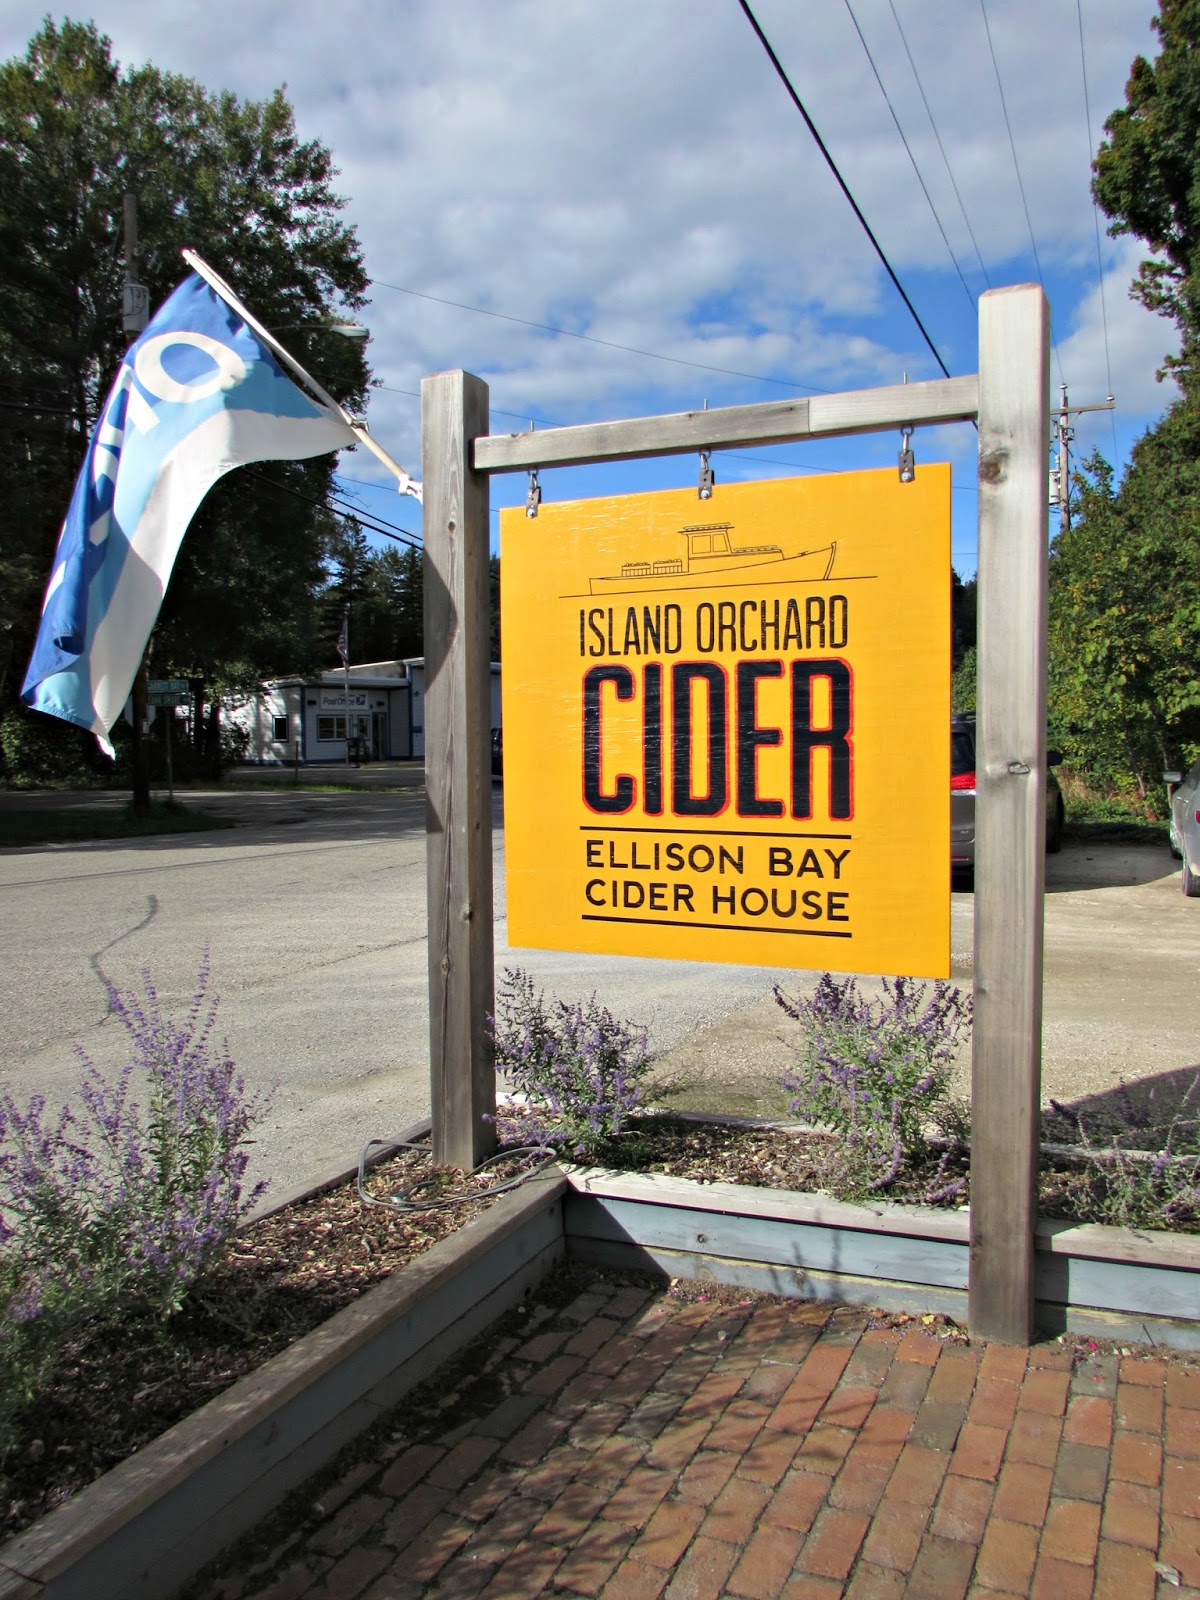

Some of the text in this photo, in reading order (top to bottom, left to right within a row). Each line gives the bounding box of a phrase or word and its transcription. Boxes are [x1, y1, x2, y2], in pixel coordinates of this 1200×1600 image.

[579, 594, 848, 657] ISLAND ORCHARD
[337, 697, 355, 706] Offce
[581, 656, 855, 822] CIDER
[586, 839, 851, 880] ELLISON BAY
[585, 878, 850, 922] CIDER HOUSE
